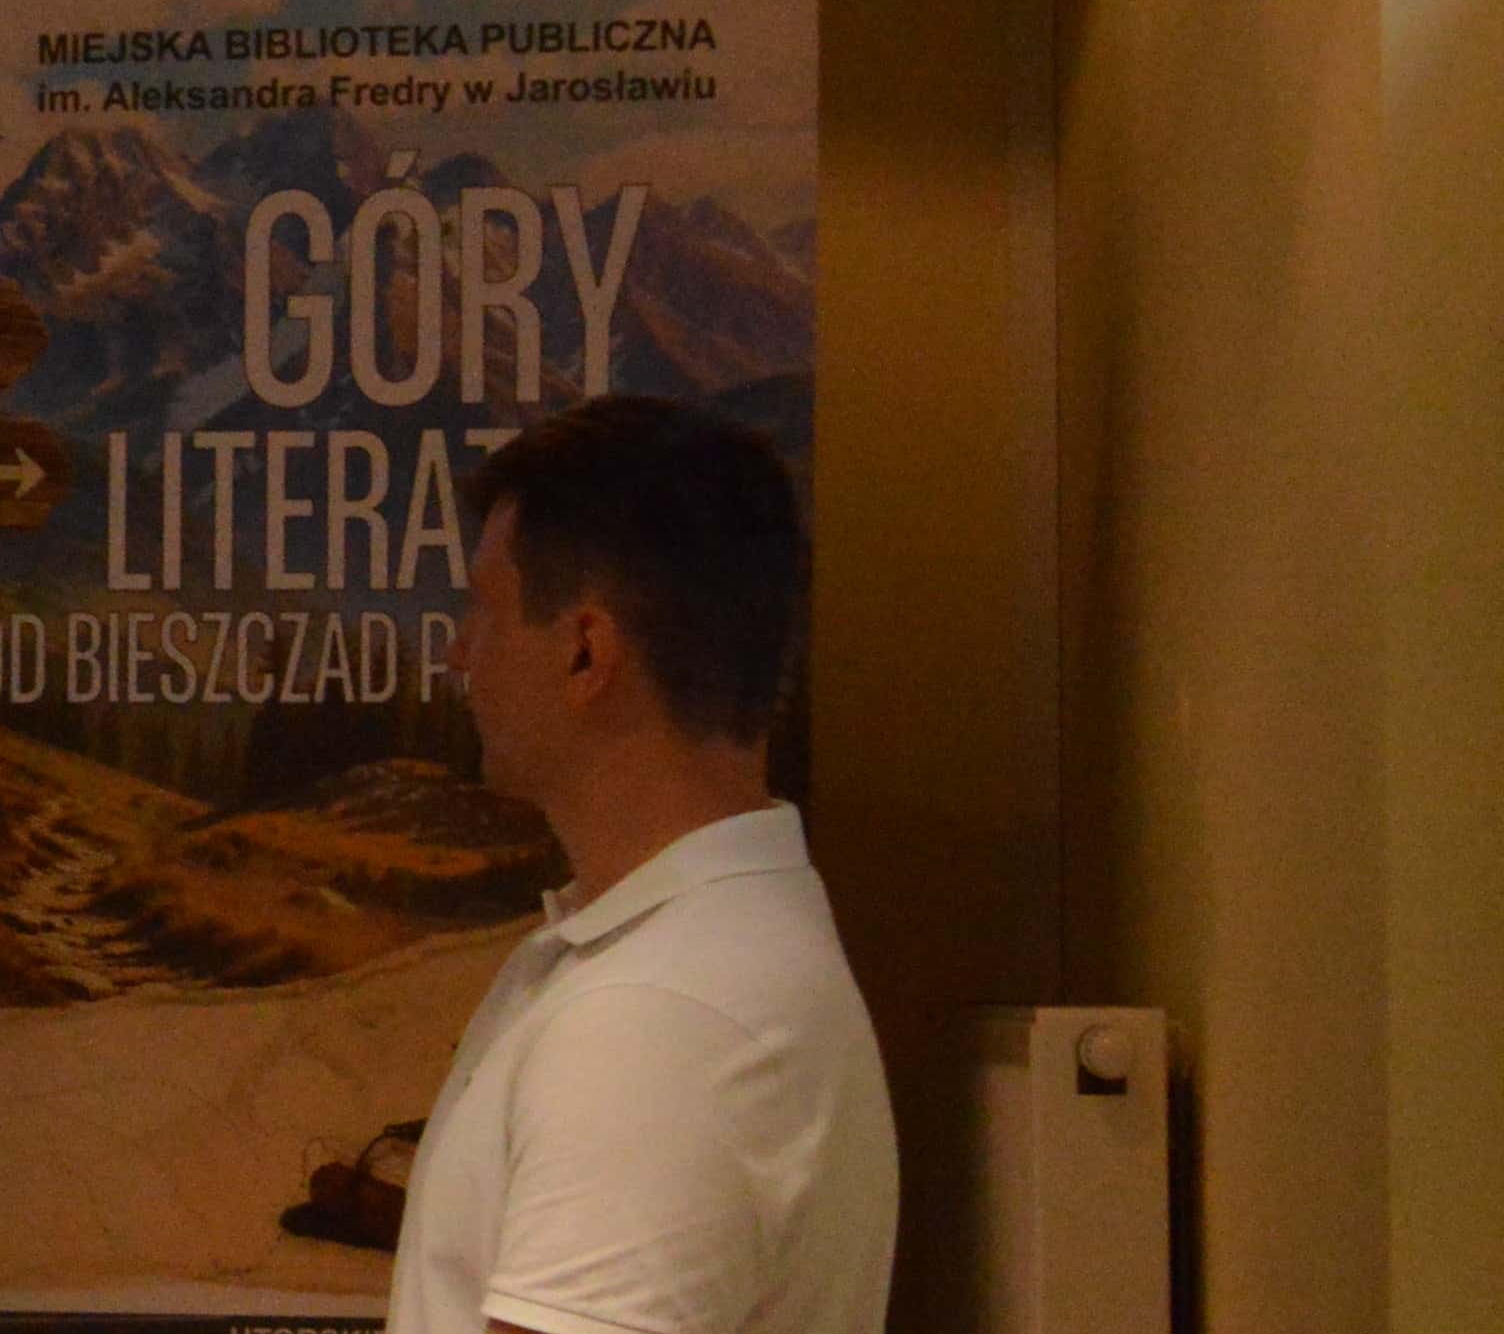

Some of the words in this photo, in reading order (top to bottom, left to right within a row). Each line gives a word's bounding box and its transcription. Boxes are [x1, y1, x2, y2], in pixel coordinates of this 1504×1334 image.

[38, 30, 212, 65] MIEJSKA
[225, 24, 469, 60] BIBLIOTEKA
[481, 18, 717, 55] PUBLICZNA
[38, 84, 90, 112] im.
[103, 78, 317, 112] Aleksandra
[330, 74, 451, 113] Fredry
[464, 80, 494, 104] w
[506, 68, 717, 103] Jarosławiu
[243, 148, 651, 409] GÓRY
[67, 610, 398, 705] BIESZCZAD
[420, 611, 471, 704] P
